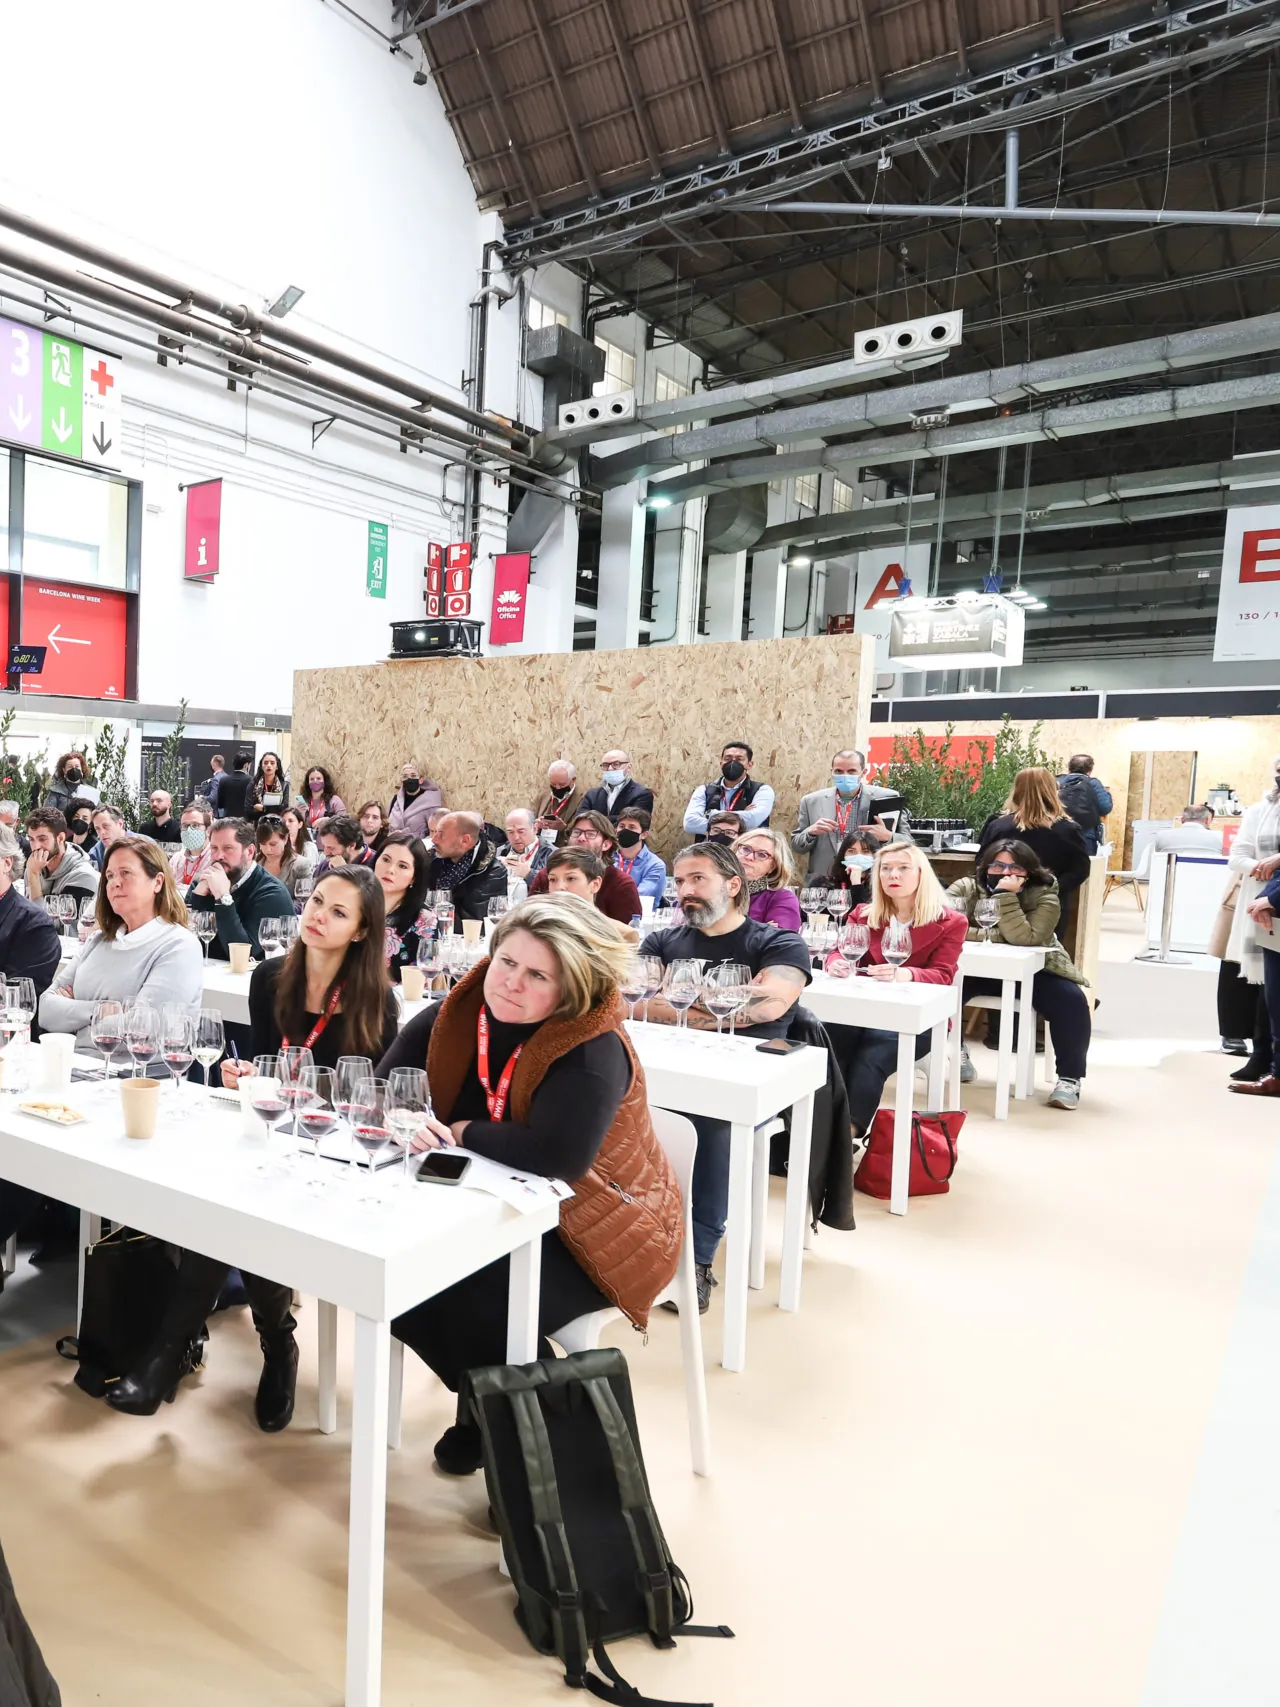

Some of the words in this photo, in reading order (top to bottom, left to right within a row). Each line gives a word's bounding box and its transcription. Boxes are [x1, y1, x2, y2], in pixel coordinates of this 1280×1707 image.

[10, 328, 30, 377] 3
[39, 587, 71, 599] BARCELONA
[71, 593, 86, 601] WINE
[864, 563, 914, 610] A
[1239, 612, 1260, 620] 130
